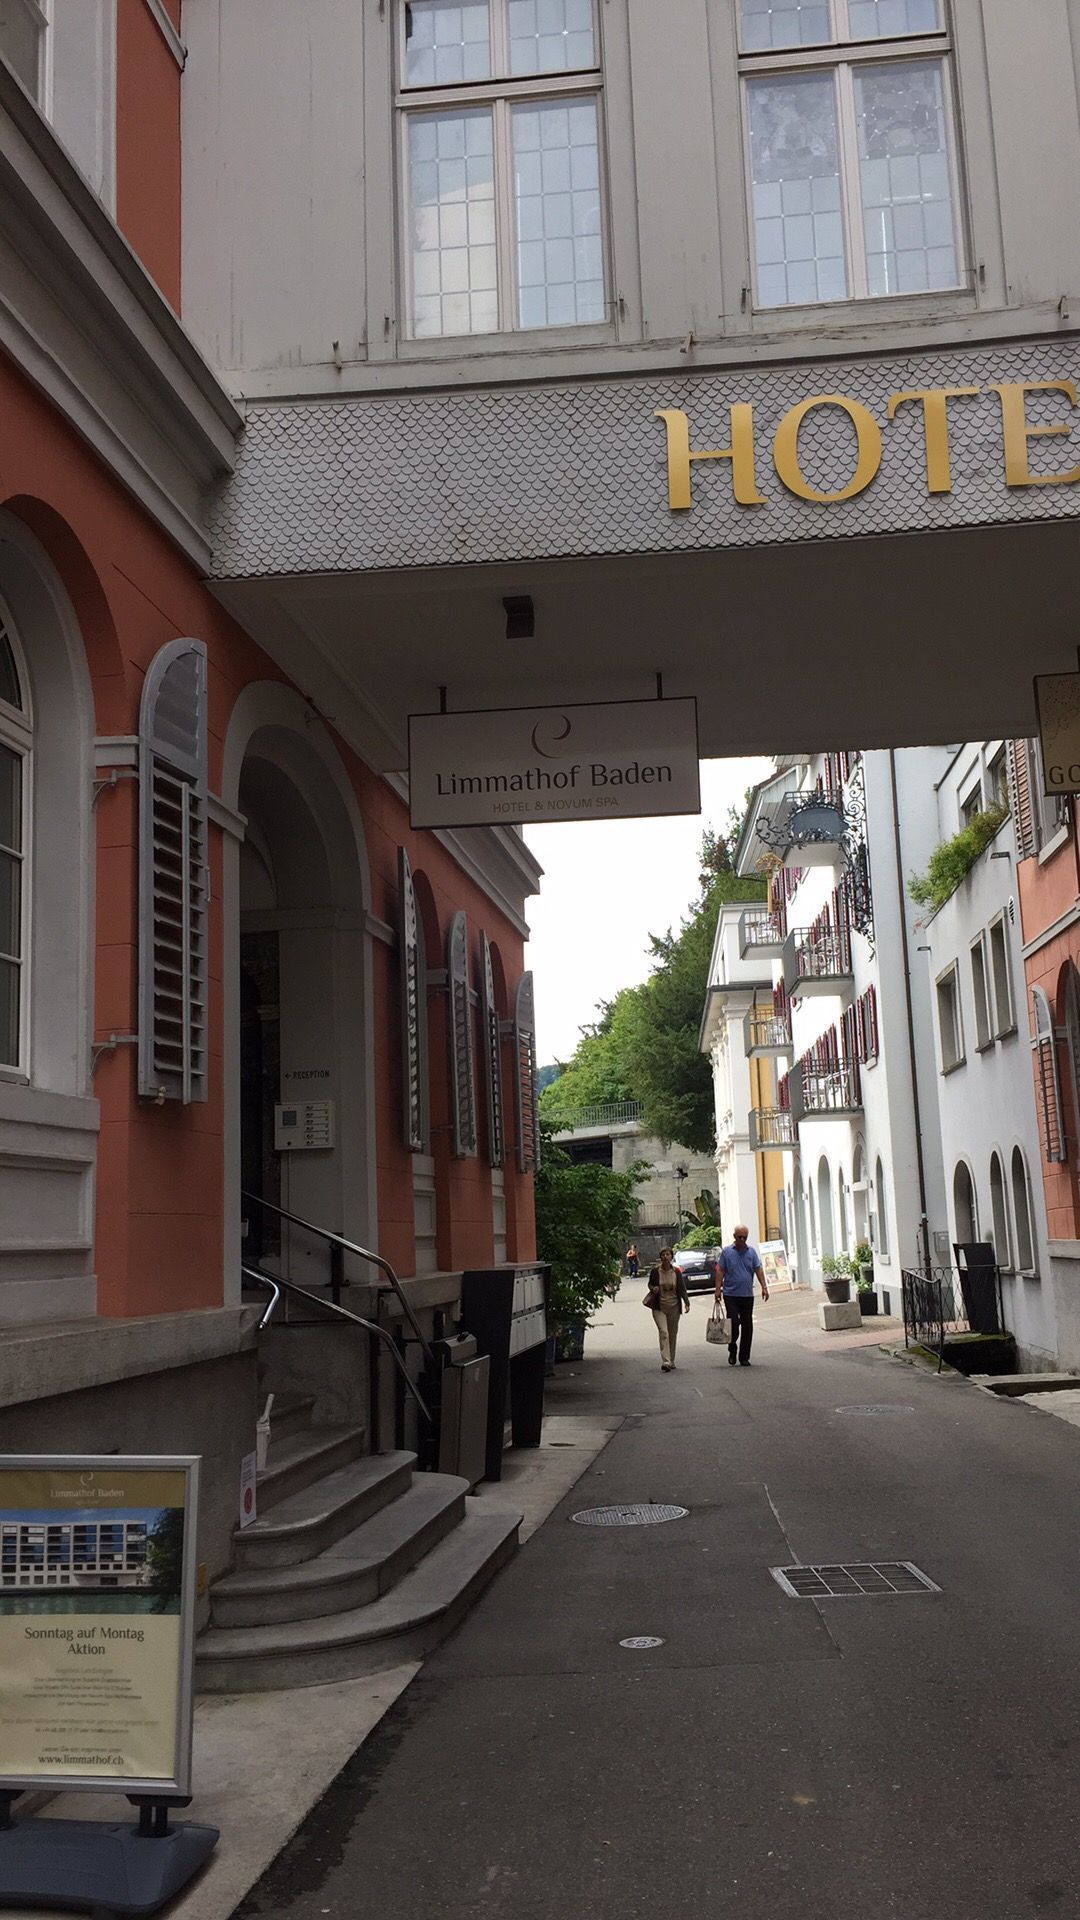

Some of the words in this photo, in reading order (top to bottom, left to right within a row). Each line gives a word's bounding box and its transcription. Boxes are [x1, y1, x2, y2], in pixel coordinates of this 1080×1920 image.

[654, 380, 1080, 509] HOTE
[436, 765, 581, 795] Limmathof
[590, 762, 672, 787] Baden
[493, 802, 532, 813] HOTEL
[534, 801, 544, 811] &
[546, 798, 592, 811] NOVUM
[595, 796, 619, 808] SPA
[292, 1070, 330, 1079] RECEPTION
[98, 1488, 124, 1497] Baden
[24, 1626, 74, 1641] Sonntag
[77, 1627, 97, 1639] auf
[99, 1628, 145, 1643] Montag
[67, 1642, 106, 1656] Aktion
[38, 1754, 124, 1766] www.limmathof.ch
